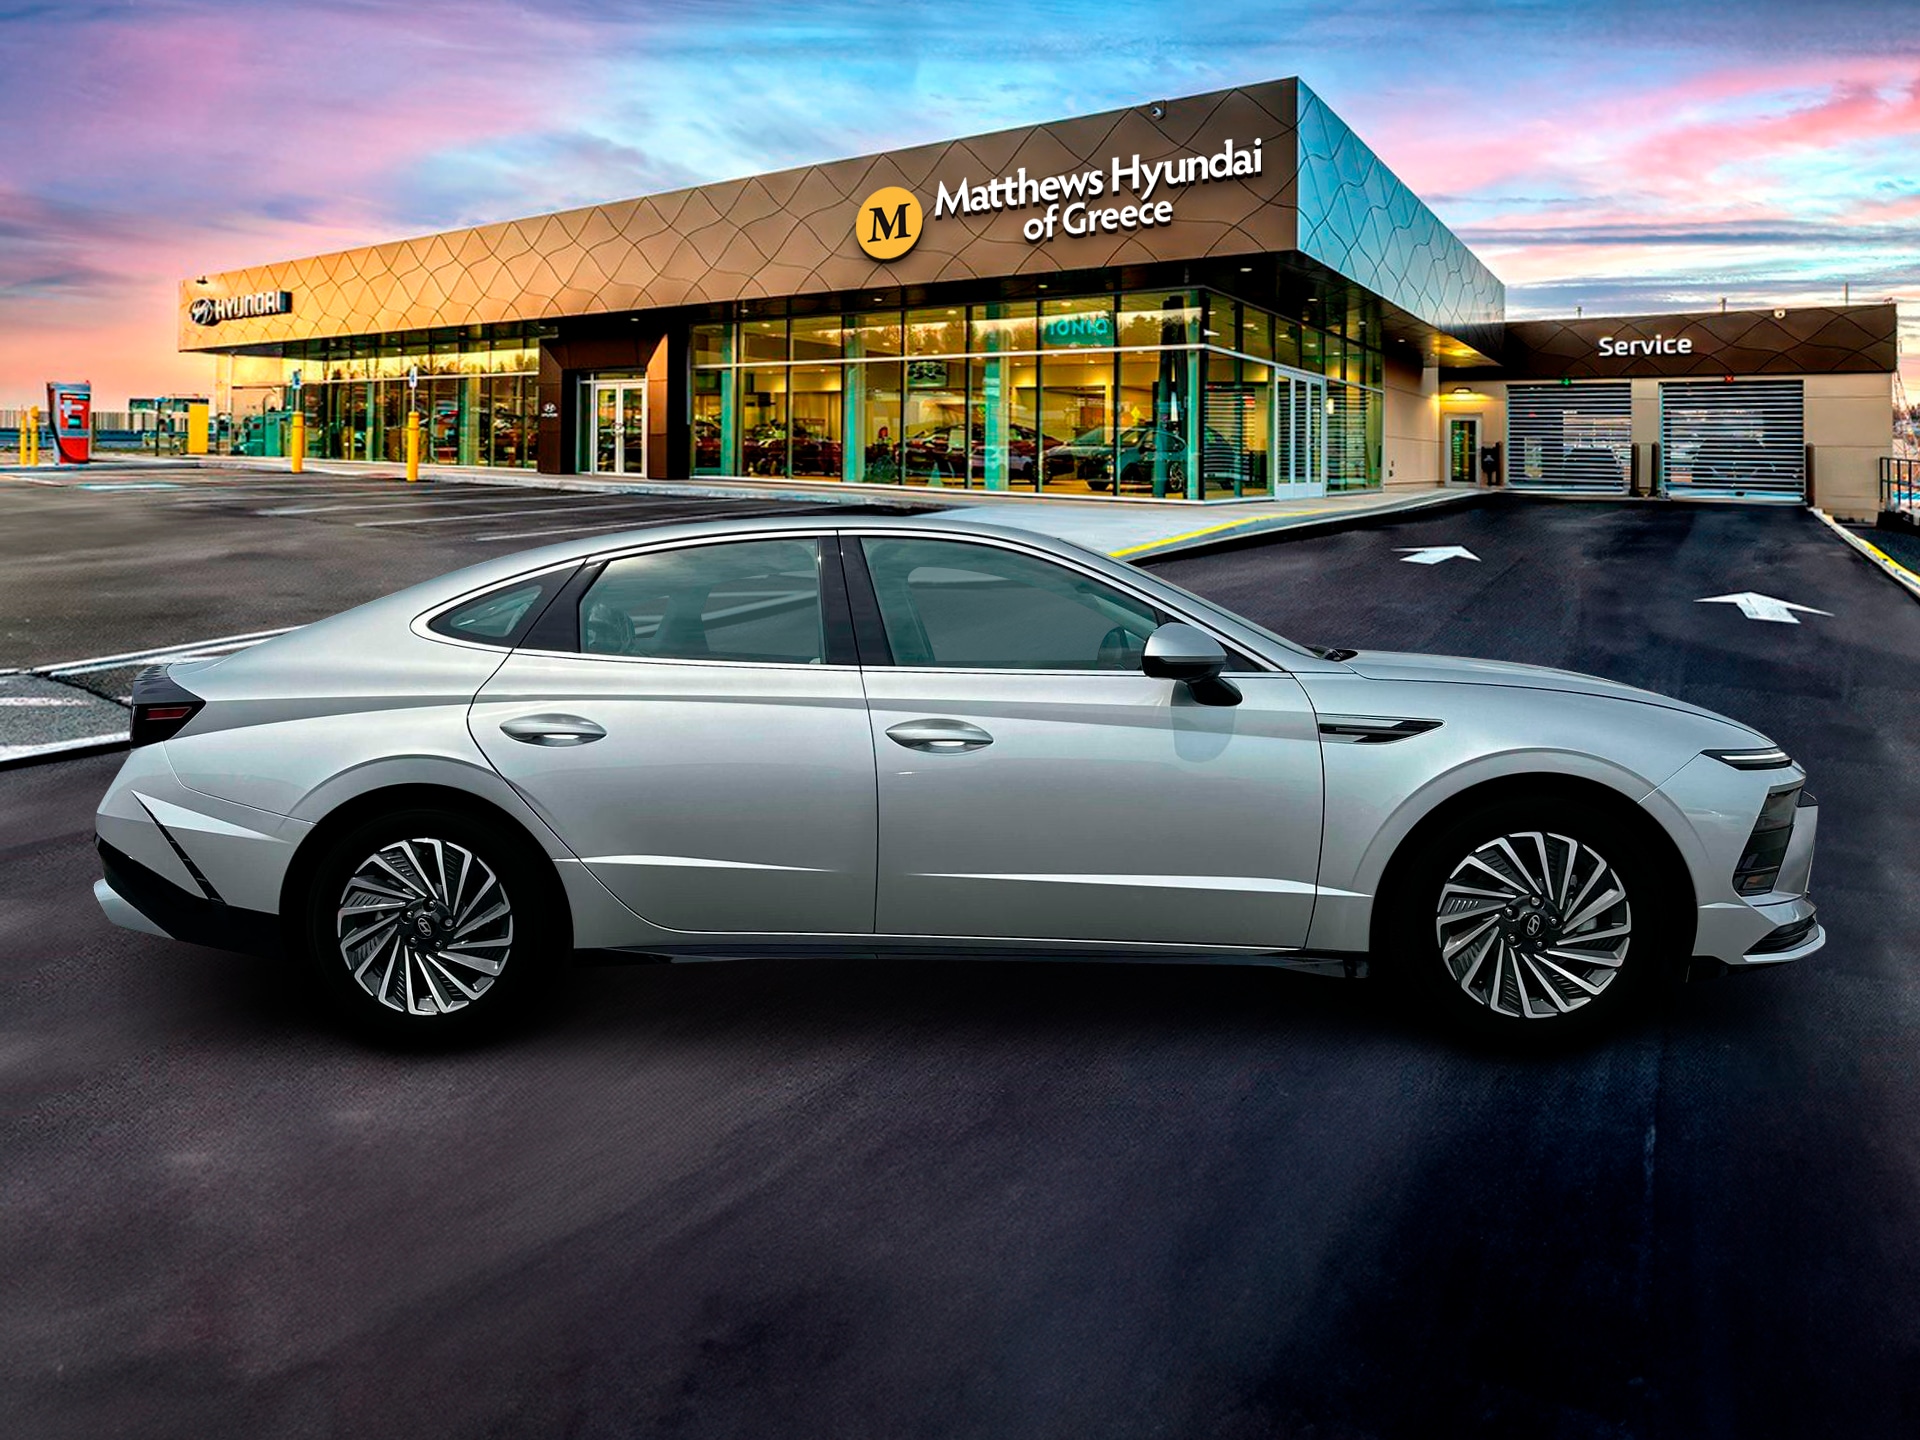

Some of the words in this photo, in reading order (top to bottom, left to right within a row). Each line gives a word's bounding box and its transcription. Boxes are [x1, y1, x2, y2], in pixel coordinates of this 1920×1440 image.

[934, 167, 1104, 217] Matthews
[1111, 138, 1262, 200] Hyundai
[867, 202, 911, 243] M
[1023, 203, 1060, 240] of
[1062, 200, 1173, 235] Greece
[214, 290, 281, 320] HYUNDAI
[1598, 334, 1693, 357] Service
